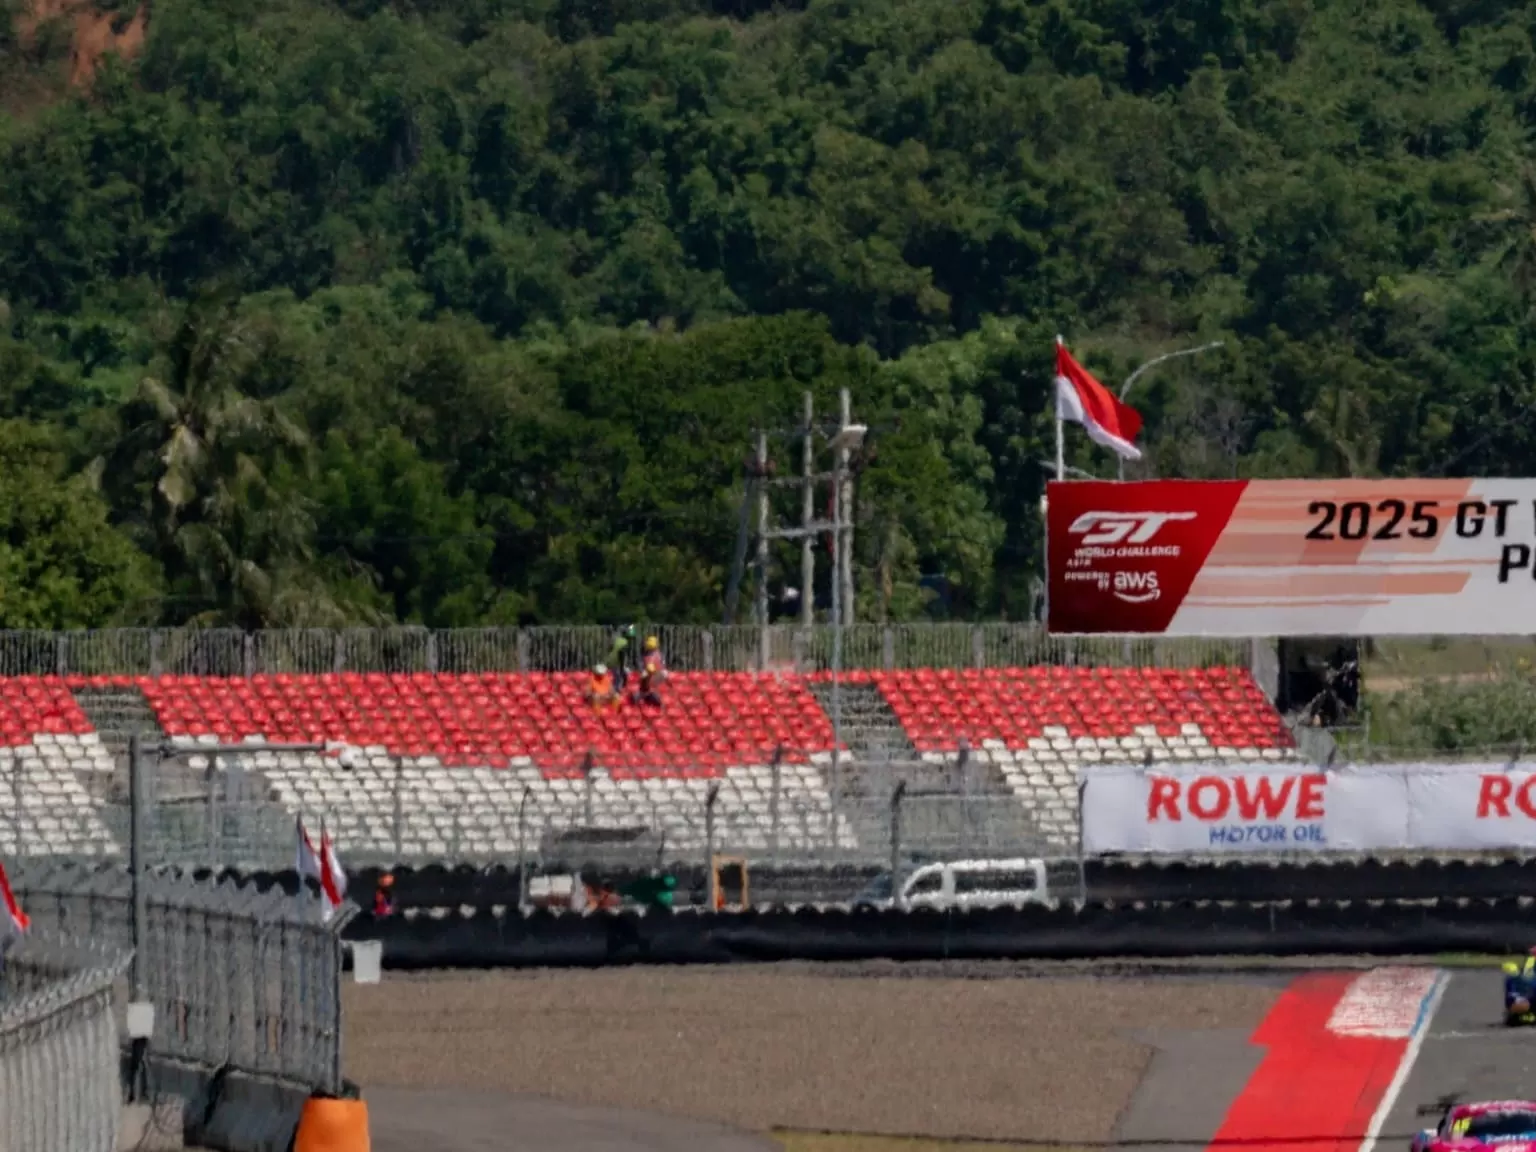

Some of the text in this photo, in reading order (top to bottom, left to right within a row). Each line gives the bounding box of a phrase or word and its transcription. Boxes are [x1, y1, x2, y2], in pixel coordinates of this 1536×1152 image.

[1305, 499, 1439, 540] 2025
[1456, 499, 1517, 538] GT
[1114, 570, 1158, 589] aws
[1147, 774, 1328, 822] ROWE
[1209, 824, 1326, 844] MOTOR OIL
